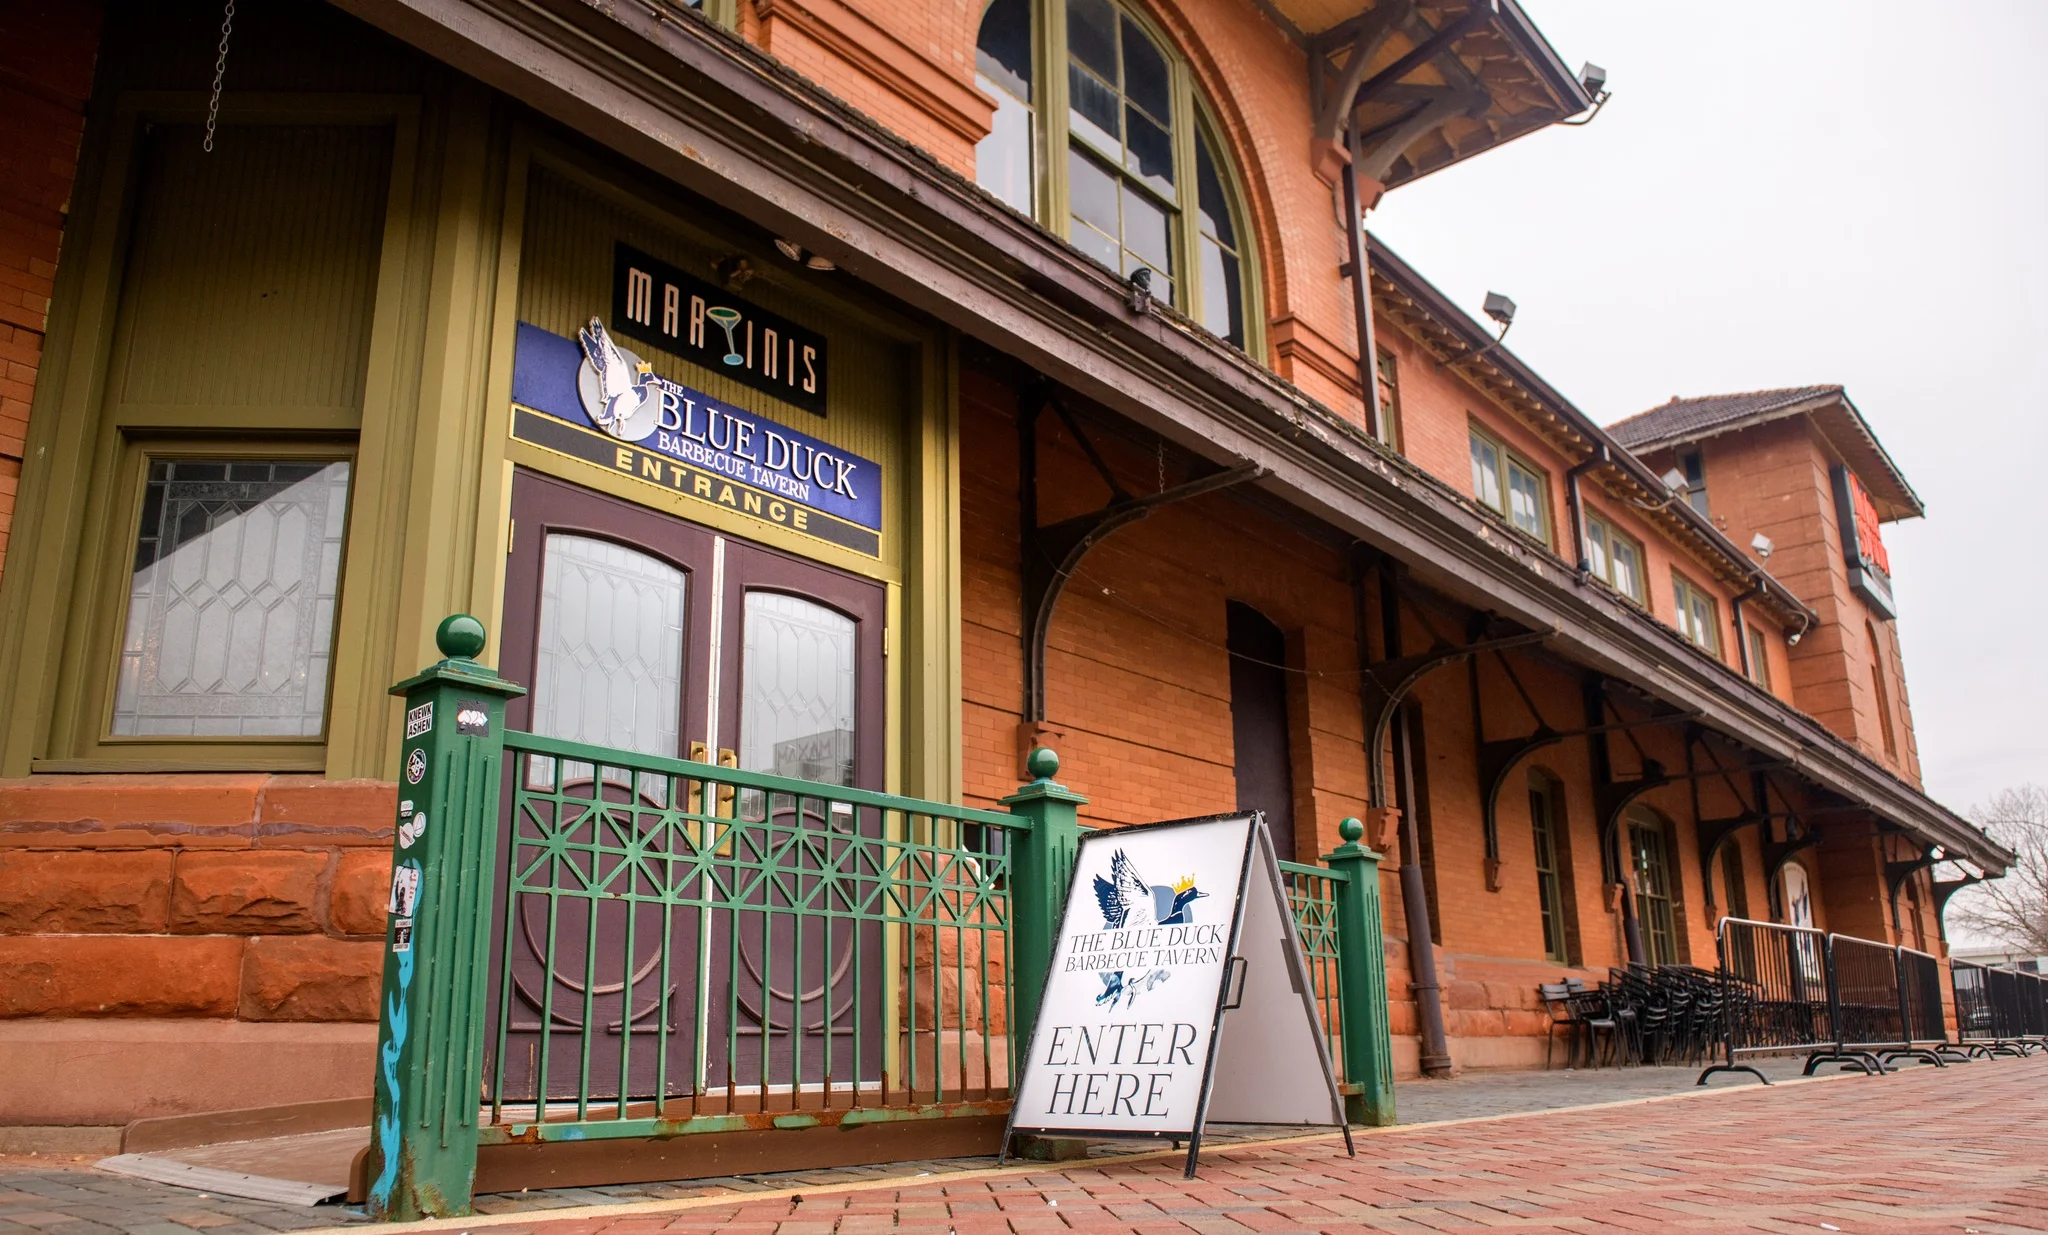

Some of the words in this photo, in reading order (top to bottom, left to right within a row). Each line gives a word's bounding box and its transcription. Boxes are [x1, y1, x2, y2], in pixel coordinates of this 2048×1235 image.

[662, 378, 684, 397] THE
[654, 386, 757, 463] BLUE
[764, 429, 858, 500] DUCK
[657, 430, 747, 480] BARBECUE
[750, 464, 810, 502] TAVERN
[615, 447, 809, 531] ENTRANCE
[408, 718, 430, 736] ASHEN
[409, 704, 431, 721] KNEWK
[1070, 933, 1107, 954] THE
[1111, 928, 1163, 950] BLUE
[1168, 923, 1226, 947] DUCK
[1064, 950, 1149, 973] BARBECUE
[1154, 946, 1222, 967] TAVERN
[1043, 1022, 1198, 1067] ENTER
[1045, 1070, 1173, 1119] HERE
